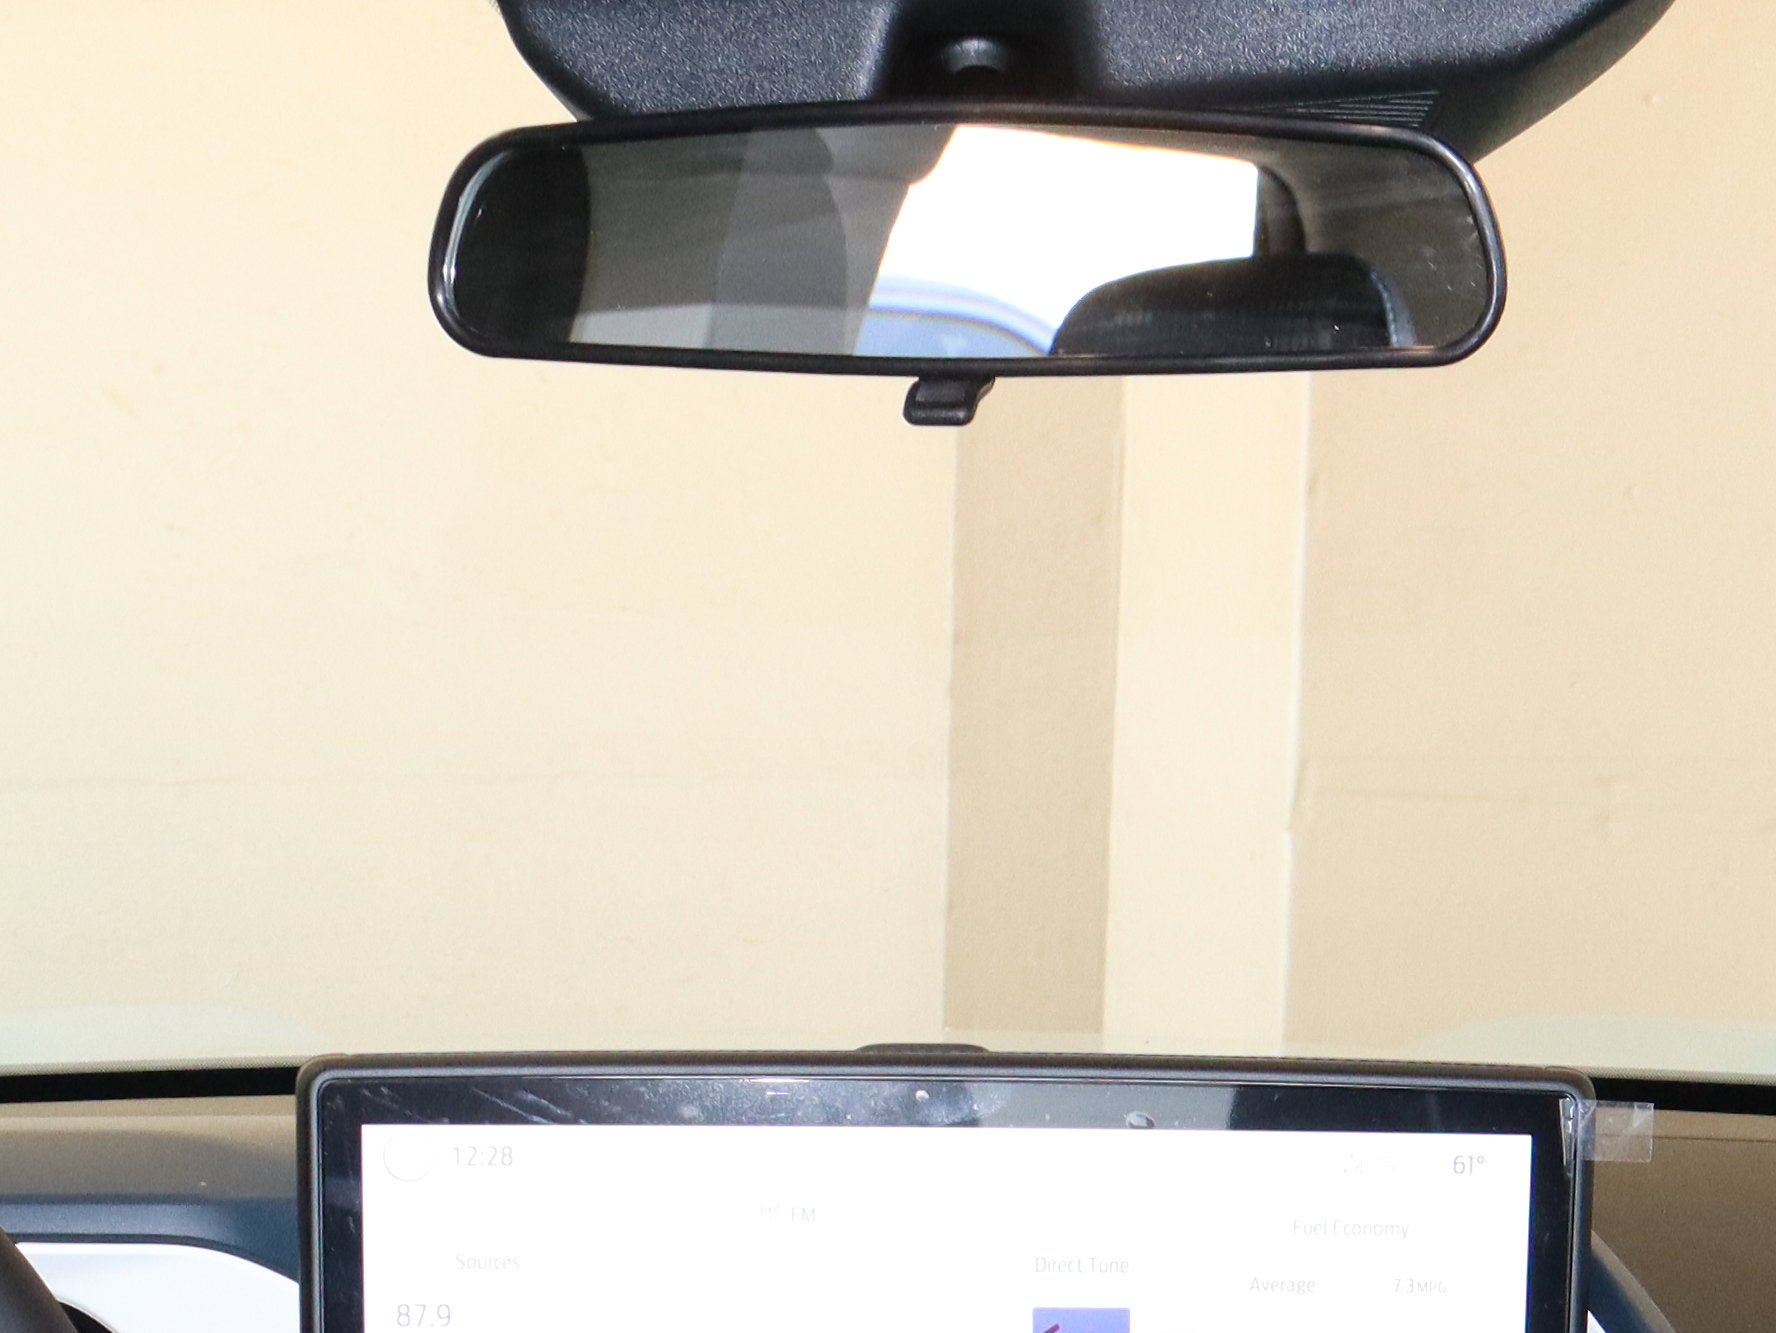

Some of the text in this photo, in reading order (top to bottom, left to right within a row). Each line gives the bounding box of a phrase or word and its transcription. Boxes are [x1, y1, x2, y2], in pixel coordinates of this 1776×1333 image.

[452, 1145, 513, 1167] 12:28
[1291, 1218, 1410, 1241] Fuel Economy
[455, 1252, 521, 1272] Sources
[1034, 1255, 1130, 1275] Direct Tune
[1248, 1276, 1317, 1297] Average
[395, 1302, 453, 1328] 87.9
